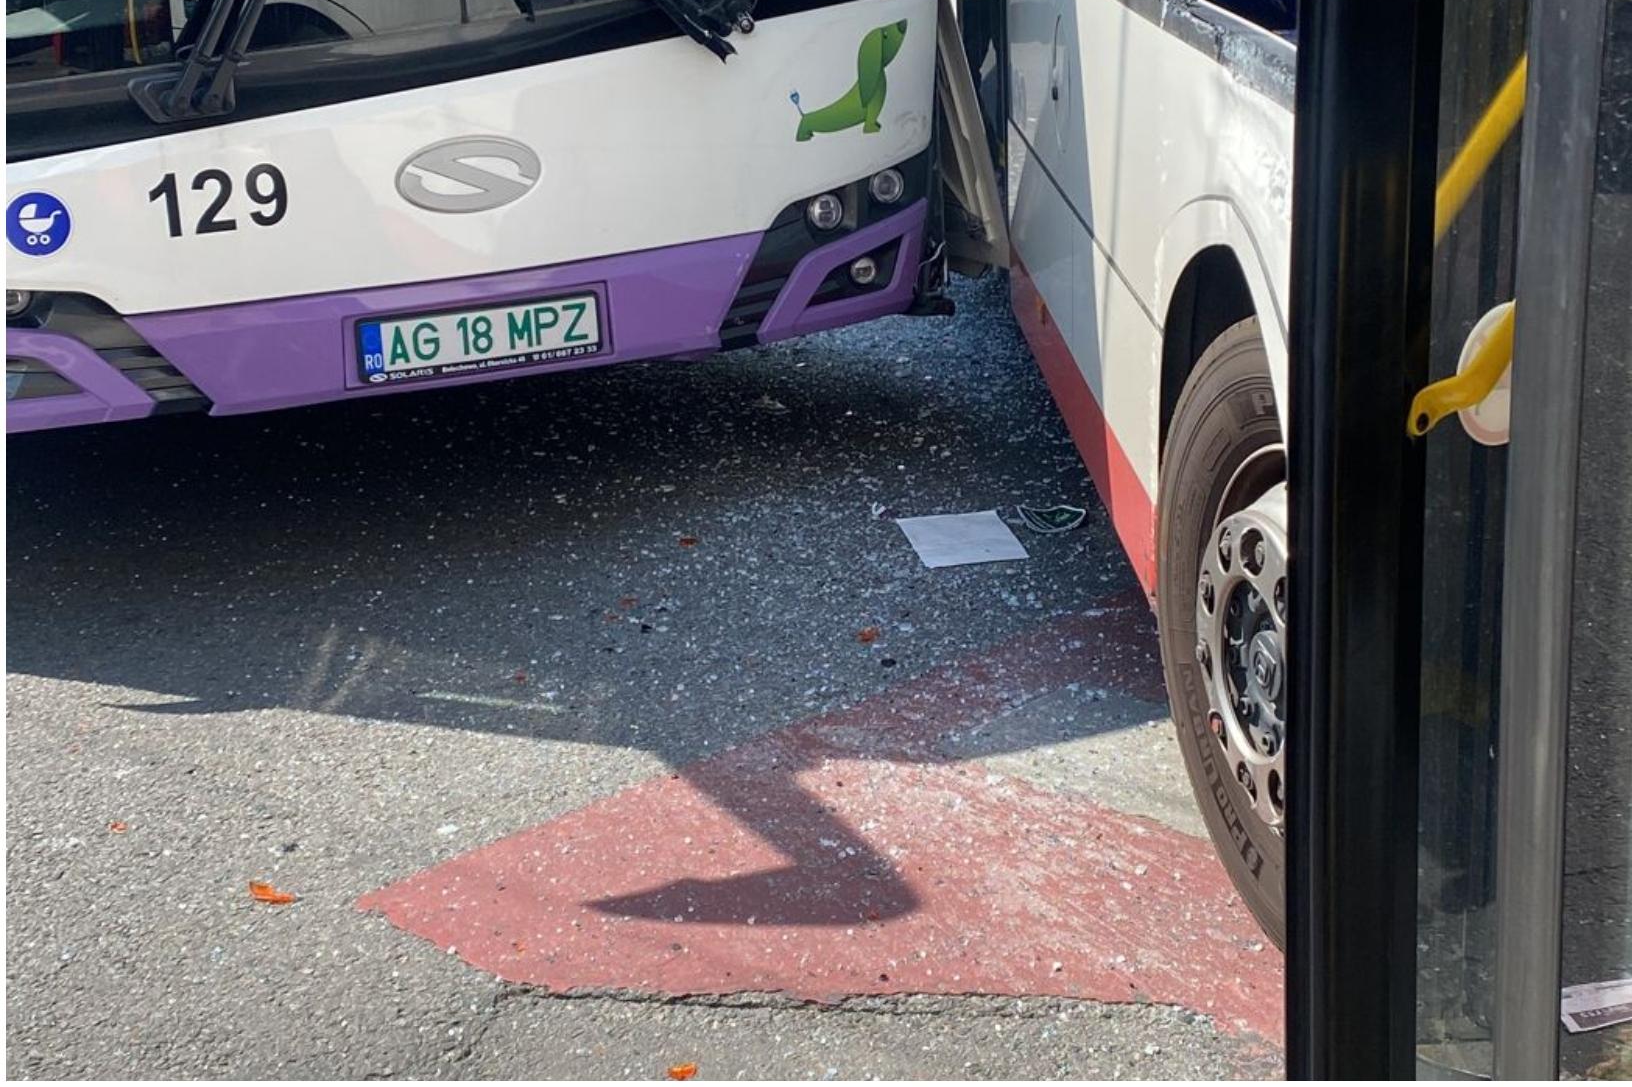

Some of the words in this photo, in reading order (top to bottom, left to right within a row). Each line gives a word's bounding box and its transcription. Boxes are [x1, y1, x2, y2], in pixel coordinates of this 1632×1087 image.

[149, 163, 288, 238] 129
[389, 322, 440, 365] AG
[456, 316, 493, 355] 18
[507, 302, 589, 350] MPZ
[365, 353, 383, 370] RO
[389, 367, 434, 380] SOLARIS
